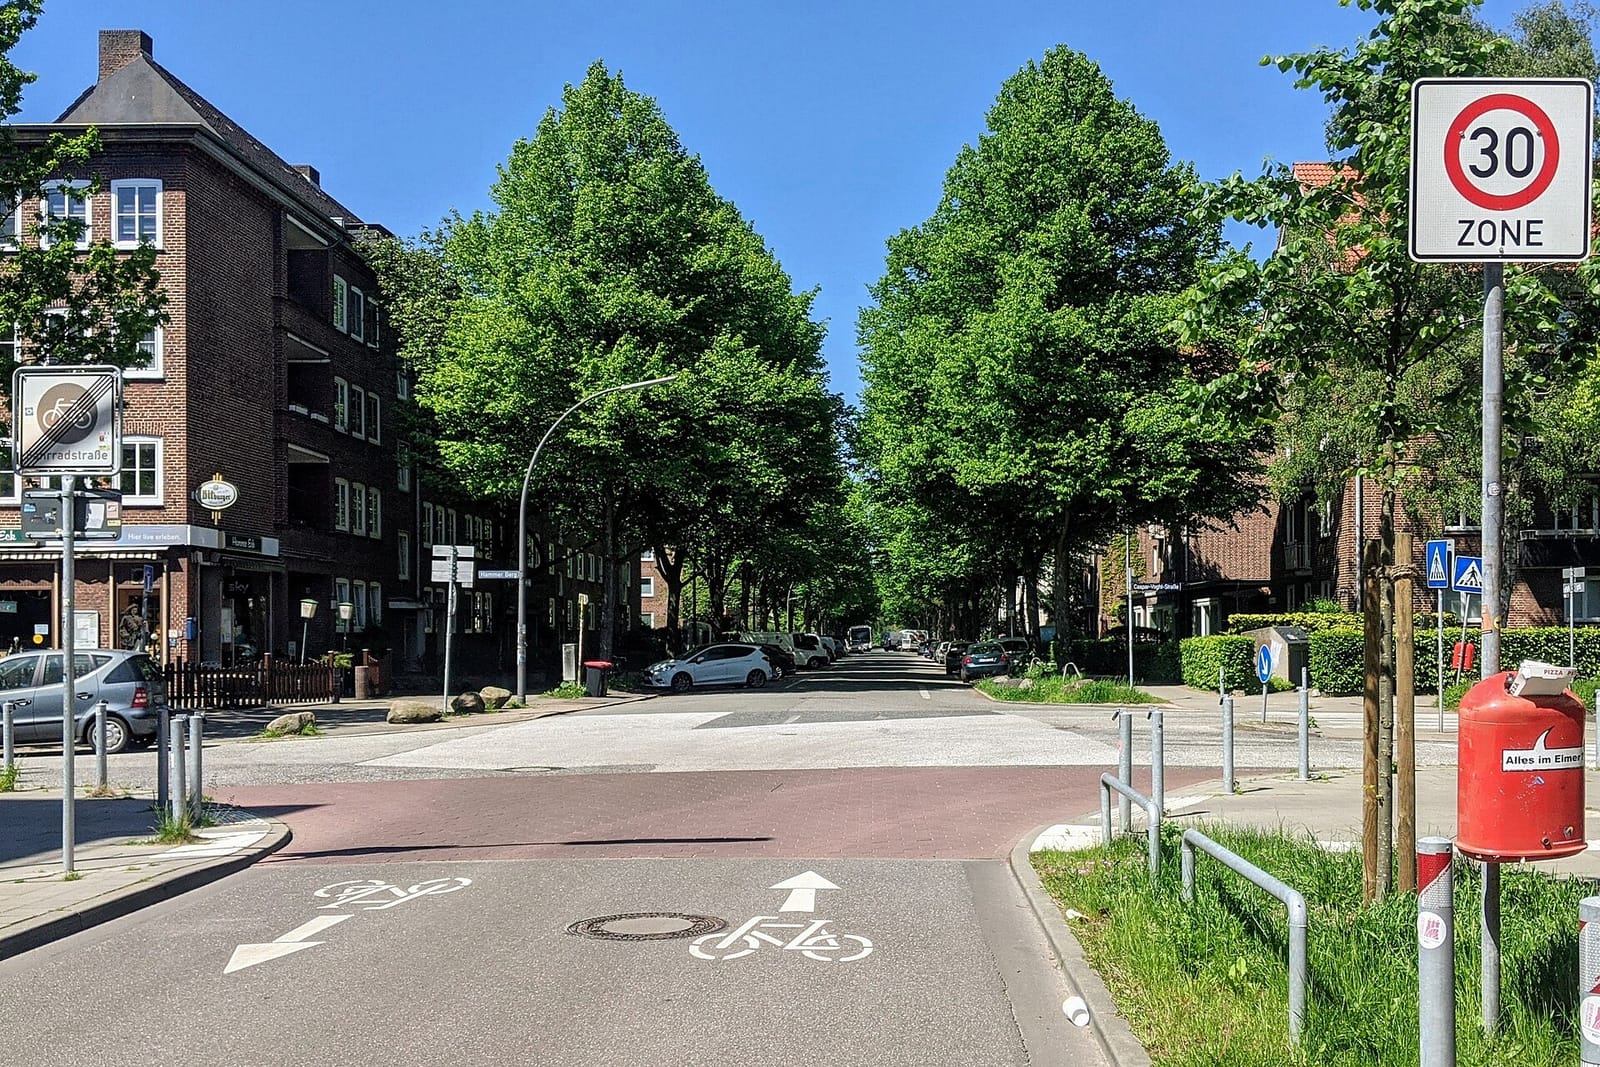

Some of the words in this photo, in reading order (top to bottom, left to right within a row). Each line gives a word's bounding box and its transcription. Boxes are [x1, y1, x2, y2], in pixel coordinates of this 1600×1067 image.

[1469, 127, 1535, 179] 30
[1457, 219, 1544, 247] ZONE
[41, 449, 109, 461] rradstraße
[1543, 668, 1563, 676] PIZZA
[1505, 755, 1535, 766] Alles
[1538, 755, 1552, 765] im
